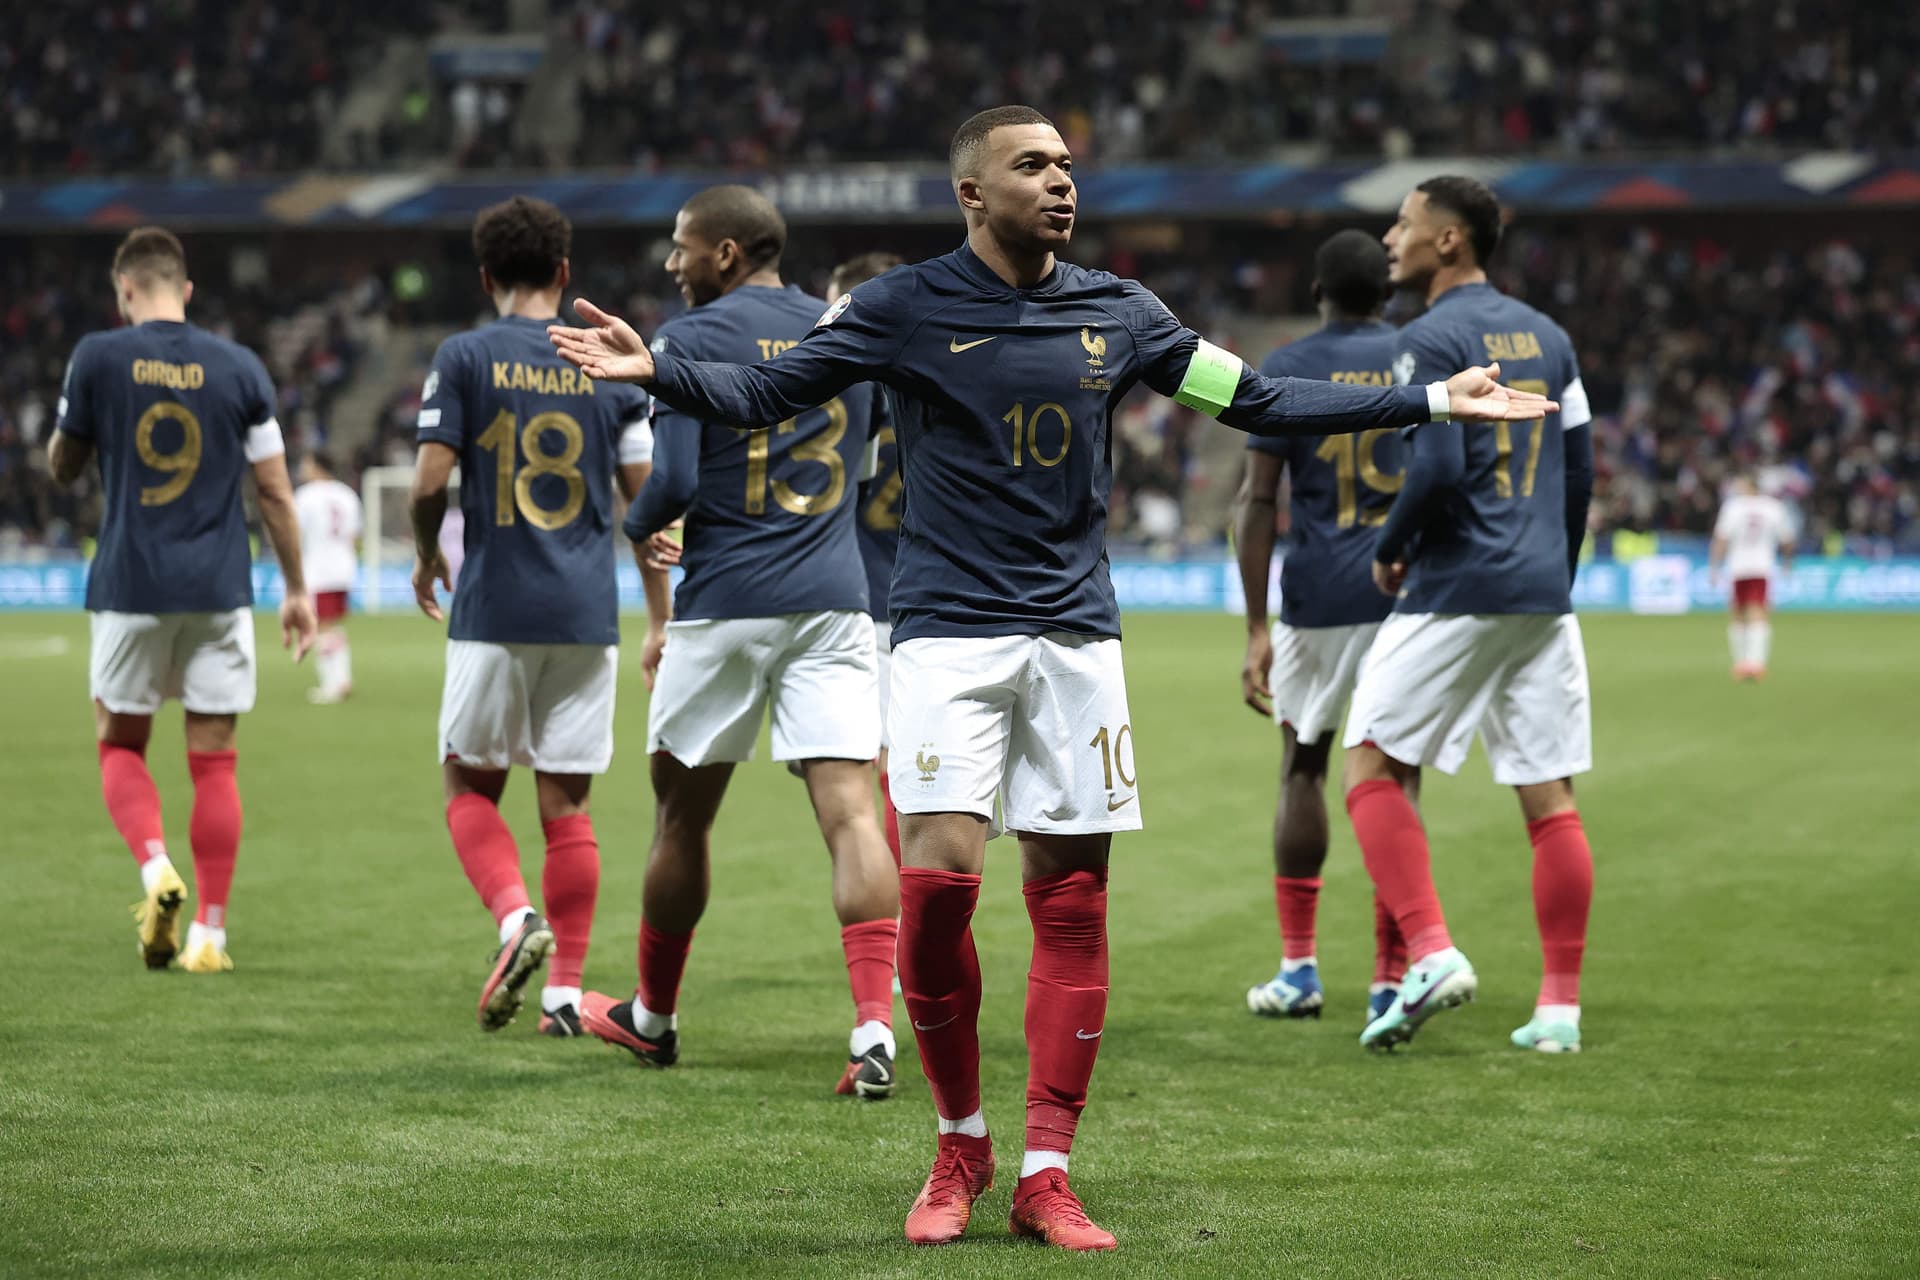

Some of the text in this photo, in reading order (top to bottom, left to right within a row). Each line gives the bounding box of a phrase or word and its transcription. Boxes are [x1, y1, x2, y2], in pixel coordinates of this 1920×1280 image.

[132, 359, 205, 390] GIROUD
[492, 361, 595, 396] KAMARA
[1483, 331, 1543, 361] SALIBA
[135, 402, 203, 507] 9
[736, 397, 848, 517] 13
[1002, 402, 1072, 467] 10
[1486, 379, 1540, 498] 17
[475, 407, 587, 531] 18
[1089, 724, 1136, 790] 10
